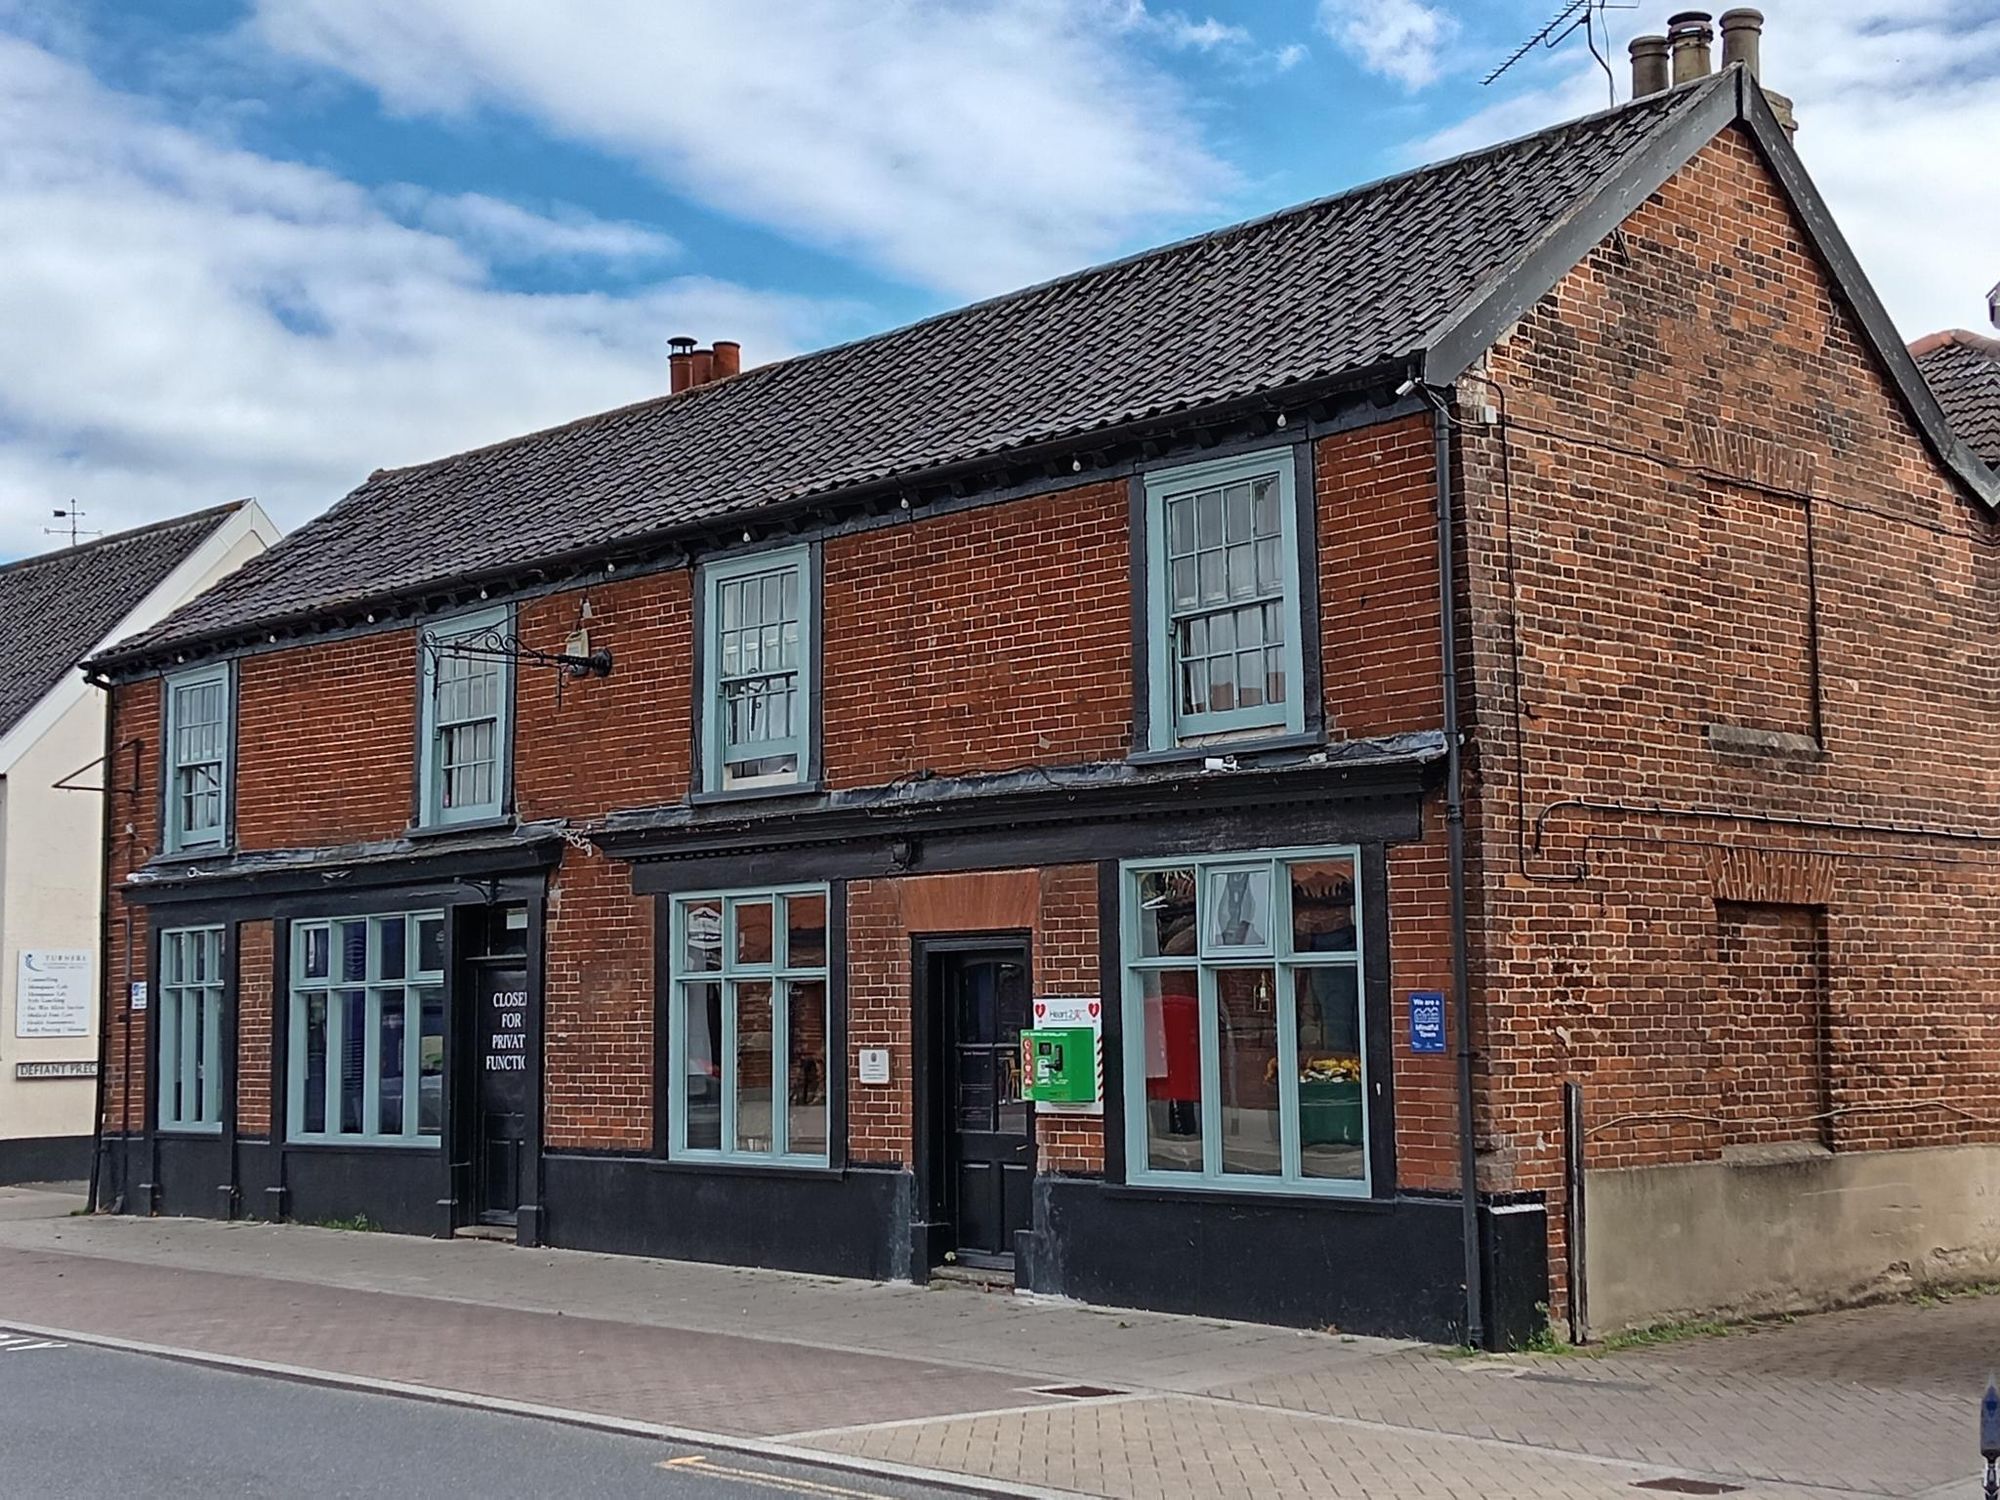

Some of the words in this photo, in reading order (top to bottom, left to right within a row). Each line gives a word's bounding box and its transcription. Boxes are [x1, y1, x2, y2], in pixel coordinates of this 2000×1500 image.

[501, 1012, 522, 1028] FOR
[492, 1034, 526, 1049] PRIVAT
[20, 1063, 65, 1075] DEFIANT
